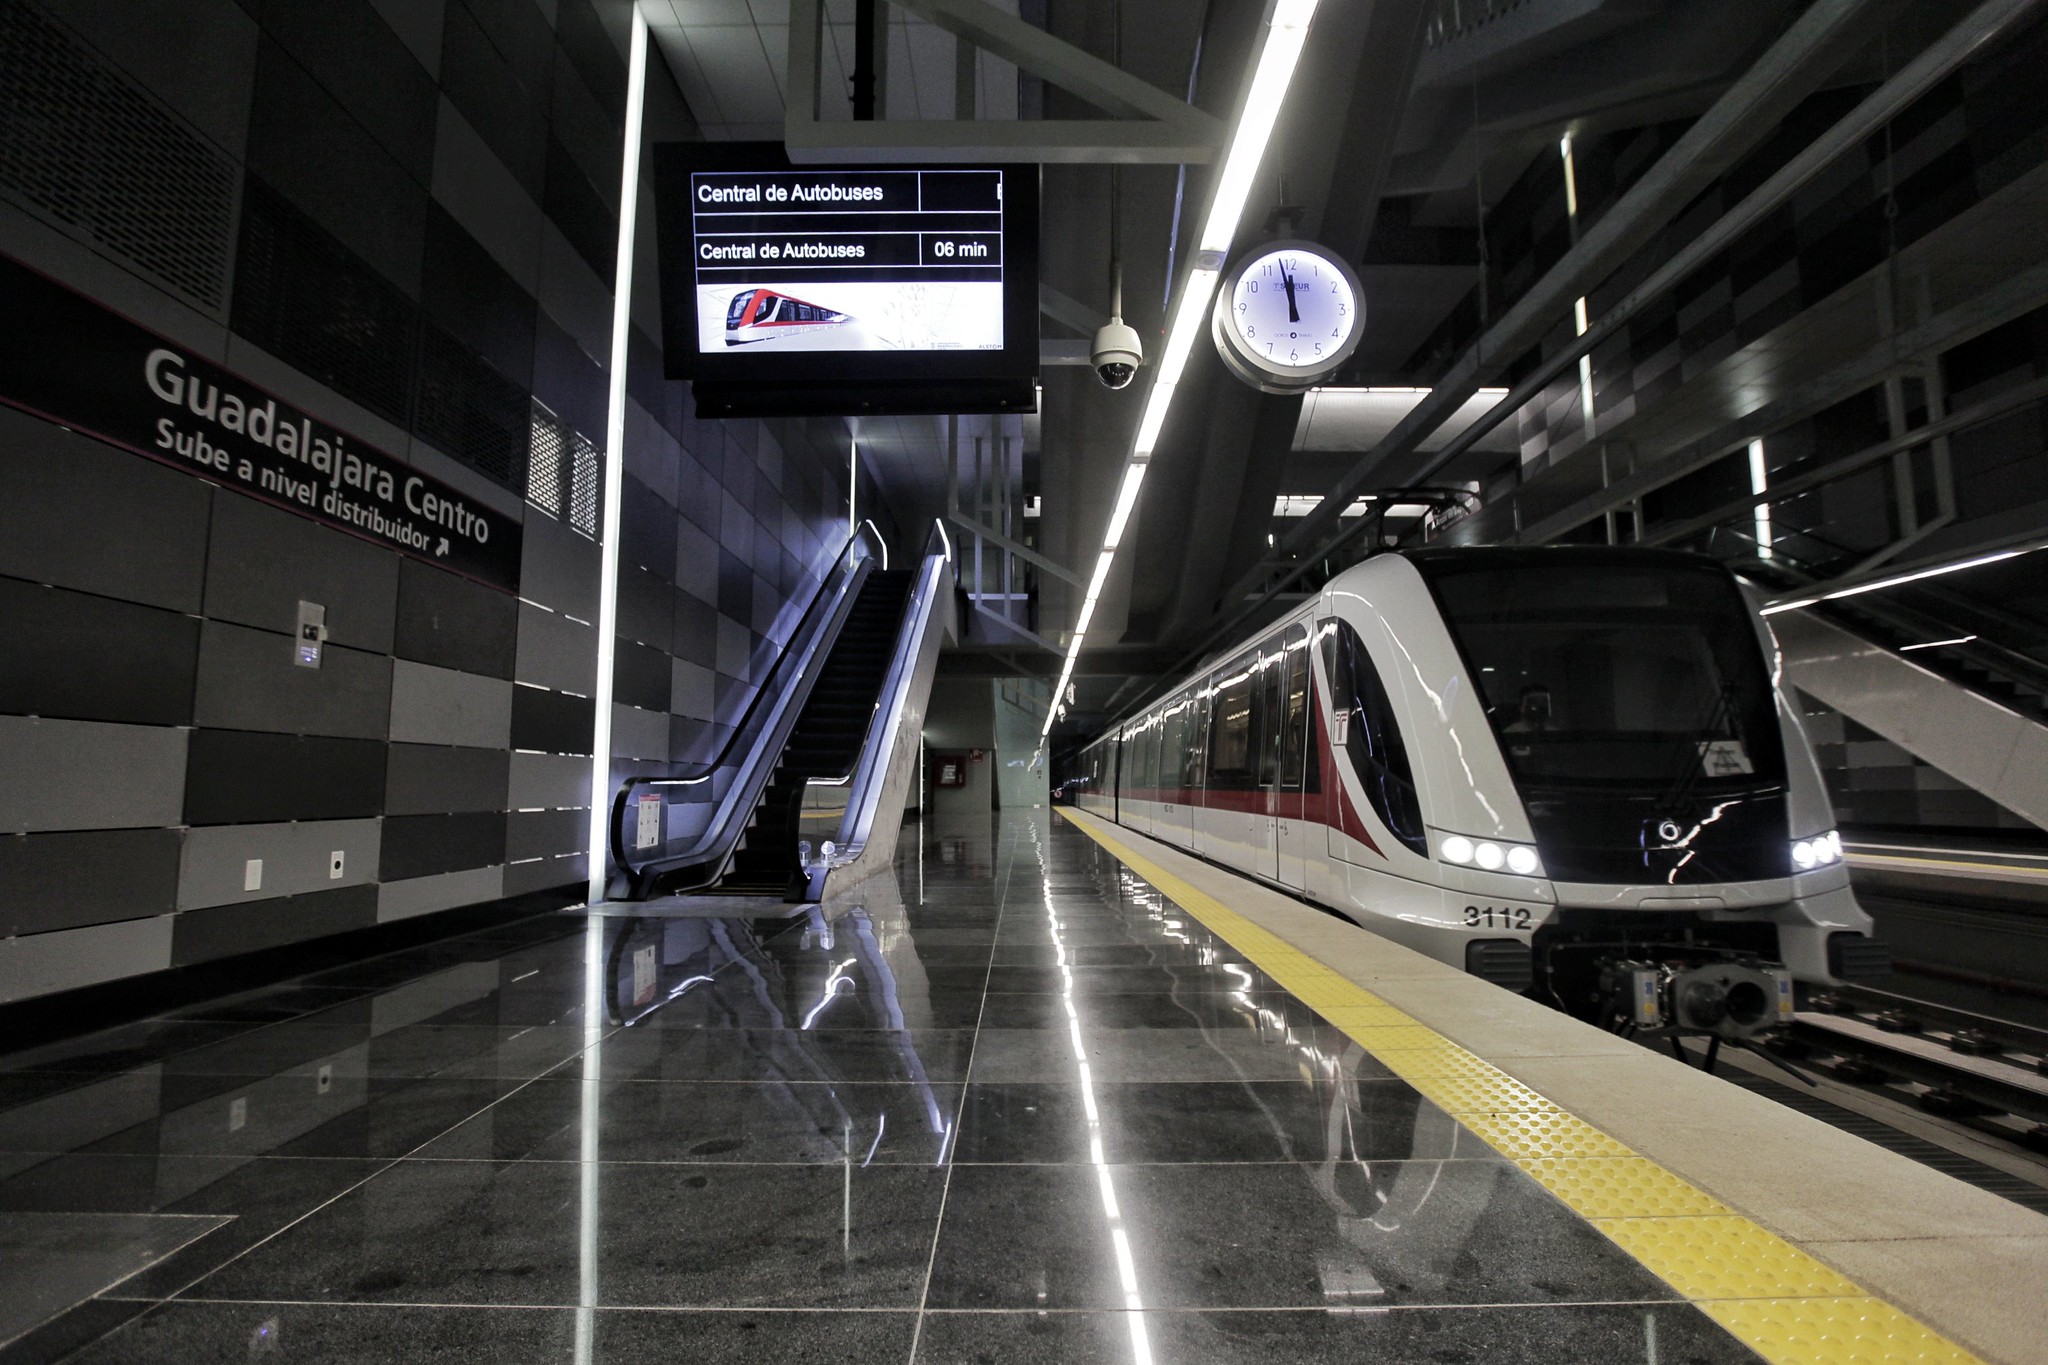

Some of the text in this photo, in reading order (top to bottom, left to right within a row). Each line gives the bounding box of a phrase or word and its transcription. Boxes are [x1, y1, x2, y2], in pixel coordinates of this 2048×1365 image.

[698, 184, 883, 202] Central de Autobuses
[700, 243, 865, 259] Central de Autobuses
[934, 241, 987, 257] 06 min
[1285, 258, 1297, 271] 12
[1262, 265, 1272, 277] 11
[1313, 266, 1318, 277] 1
[1246, 280, 1259, 293] 10
[1331, 282, 1338, 293] 2
[1239, 303, 1247, 315] 9
[1339, 304, 1346, 316] 3
[1247, 326, 1256, 338] 8
[1331, 327, 1339, 338] 4
[1266, 343, 1274, 355] 7
[1290, 349, 1298, 361] 6
[1315, 343, 1322, 355] 5
[145, 348, 489, 544] Guadalajara Centro
[155, 417, 430, 550] Sube a nivel distribuidor
[1463, 905, 1532, 930] 3112
